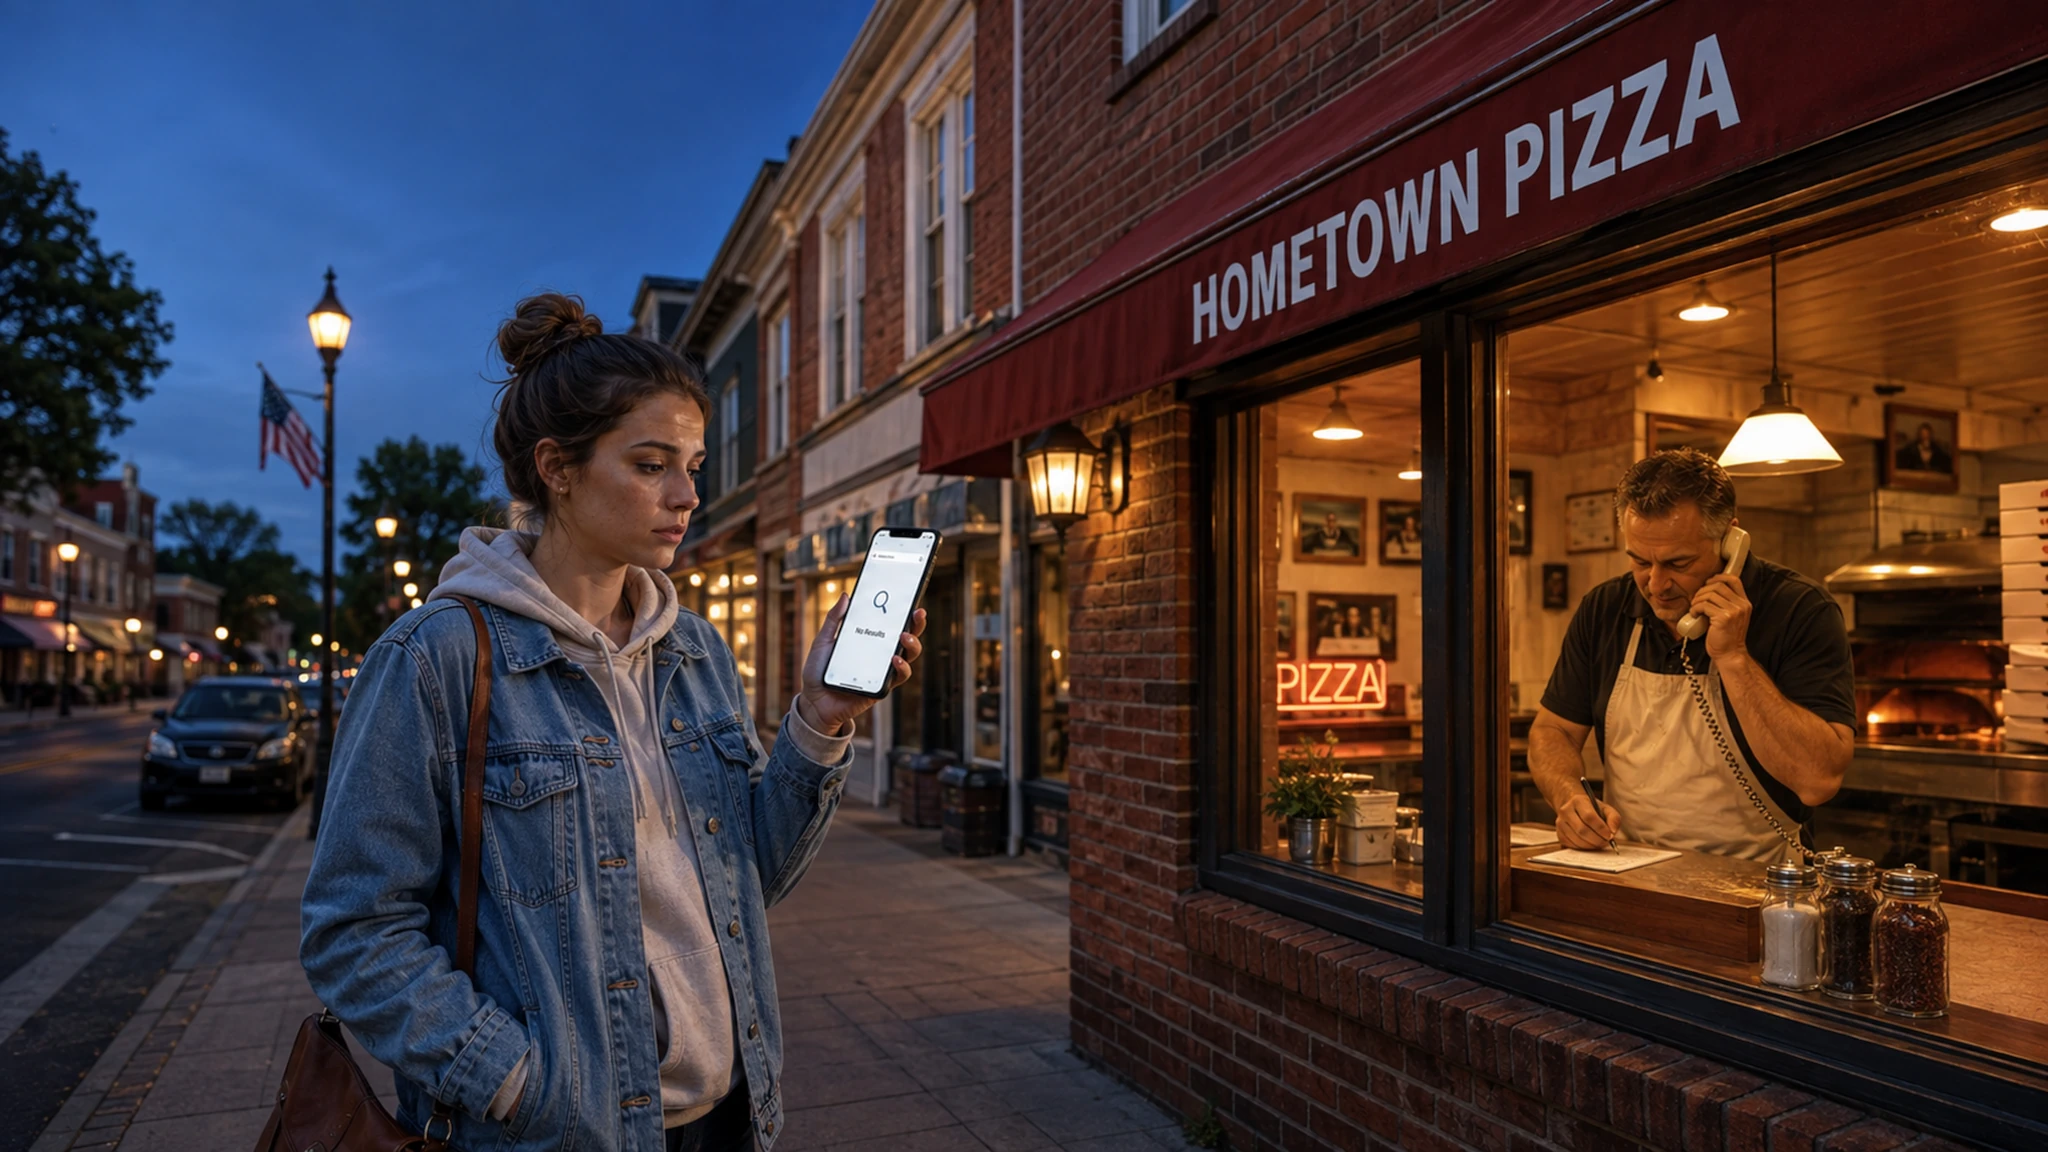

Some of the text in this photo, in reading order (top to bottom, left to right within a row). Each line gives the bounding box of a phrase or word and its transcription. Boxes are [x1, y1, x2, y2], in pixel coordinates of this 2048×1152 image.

[1193, 34, 1740, 344] HOMETOWN PIZZA
[855, 627, 886, 638] No Results
[1276, 662, 1383, 704] PIZZA
